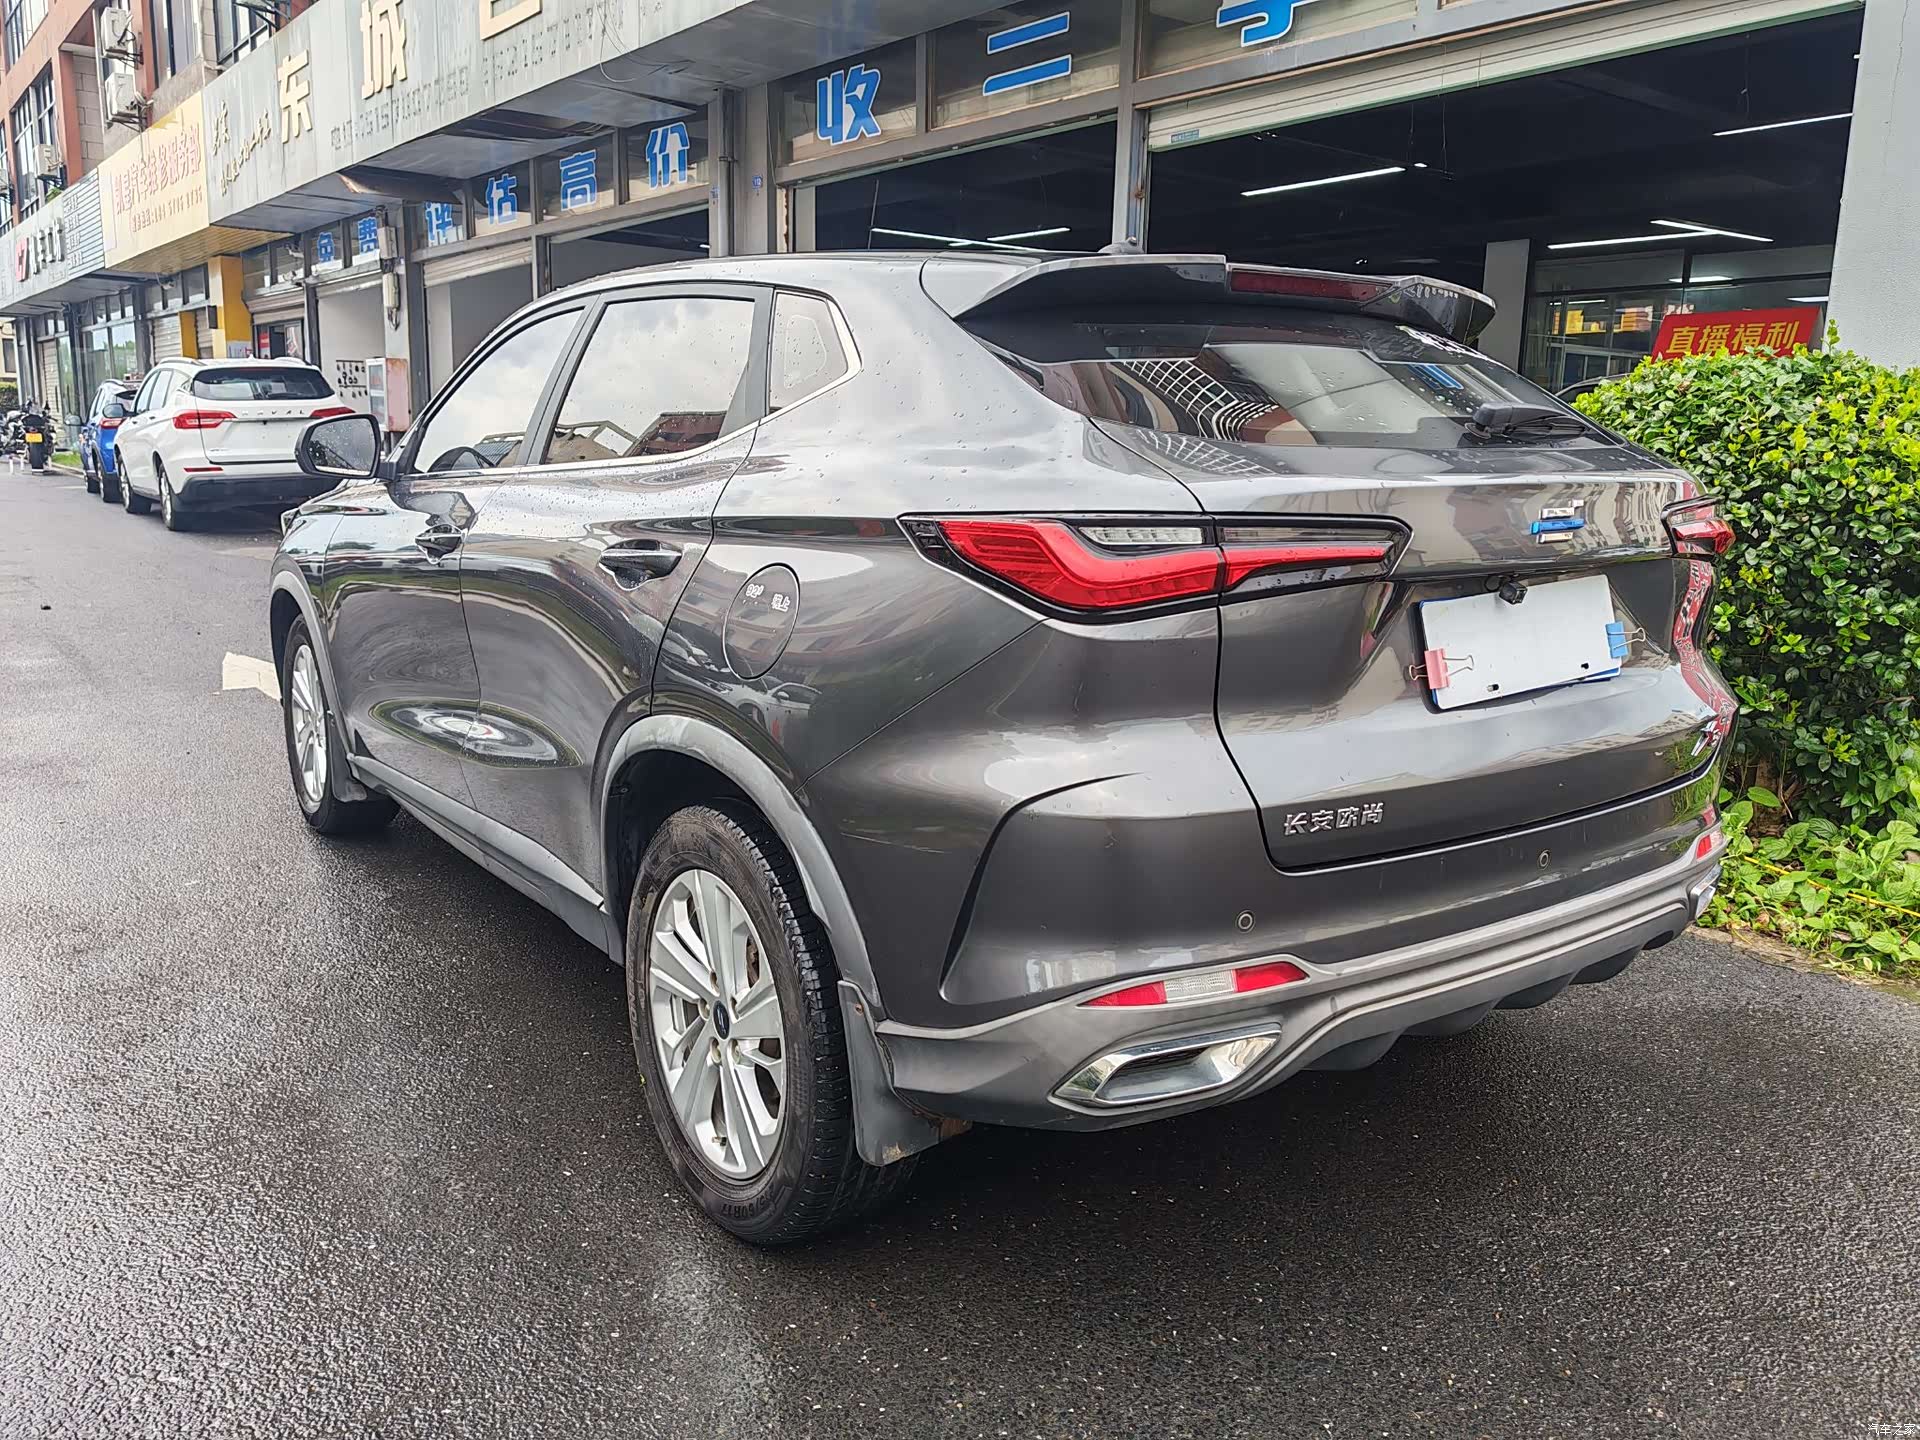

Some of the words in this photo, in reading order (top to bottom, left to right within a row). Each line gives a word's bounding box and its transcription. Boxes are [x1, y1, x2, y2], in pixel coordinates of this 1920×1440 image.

[1666, 321, 1800, 356] 直播福利
[1284, 803, 1383, 835] 长安欧尚
